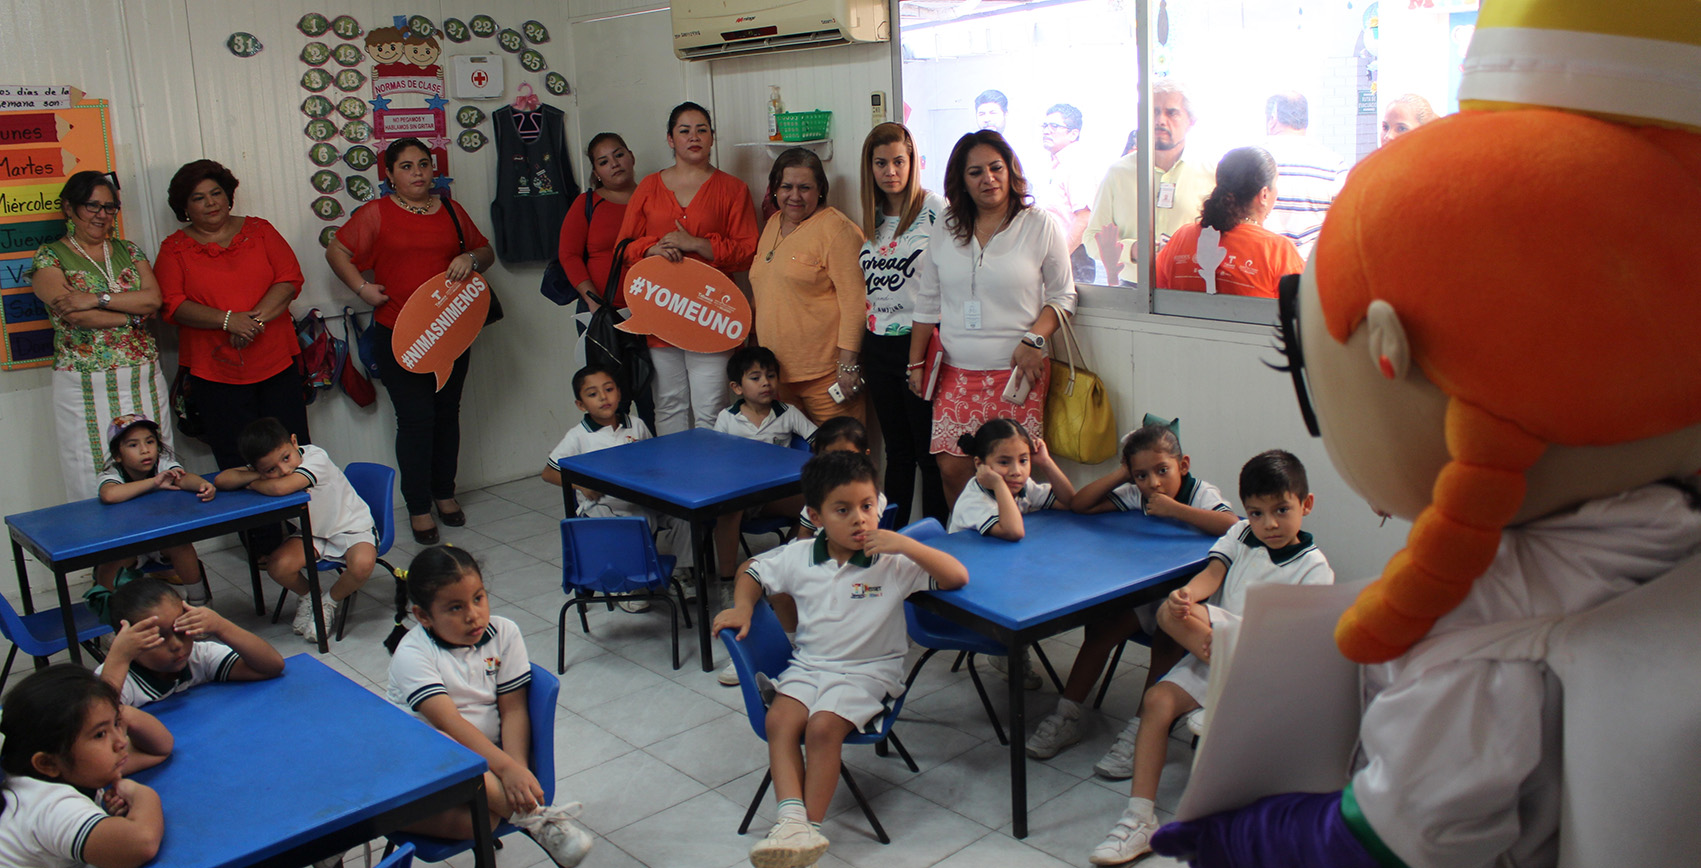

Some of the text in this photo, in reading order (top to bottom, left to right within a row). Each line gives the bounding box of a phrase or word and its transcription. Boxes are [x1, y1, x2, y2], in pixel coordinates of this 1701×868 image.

[310, 19, 318, 32] 1
[338, 21, 353, 36] 11
[412, 20, 431, 35] 20
[447, 23, 464, 39] 21
[473, 20, 492, 33] 22
[525, 24, 544, 41] 24
[234, 35, 253, 53] 31
[502, 33, 520, 50] 23
[310, 48, 321, 61] 2
[339, 48, 356, 61] 12
[522, 53, 540, 70] 25
[0, 88, 10, 96] os
[45, 87, 56, 96] de
[61, 87, 70, 96] la
[375, 80, 442, 94] NORMAS DE CLASE
[547, 75, 565, 93] 26
[310, 99, 322, 114] 4
[344, 102, 359, 117] 14
[460, 110, 478, 124] 27
[0, 127, 42, 140] unes
[316, 124, 327, 137] 5
[349, 125, 365, 139] 15
[385, 123, 409, 131] HABLAMOS
[462, 133, 481, 147] 28
[318, 147, 328, 162] 6
[351, 151, 369, 165] 16
[321, 174, 331, 190] 7
[350, 181, 370, 197] 17
[320, 201, 332, 216] 8
[865, 273, 905, 295] Love
[629, 276, 743, 339] #YOMEUNO
[401, 277, 486, 369] #NIMASNIMENOS
